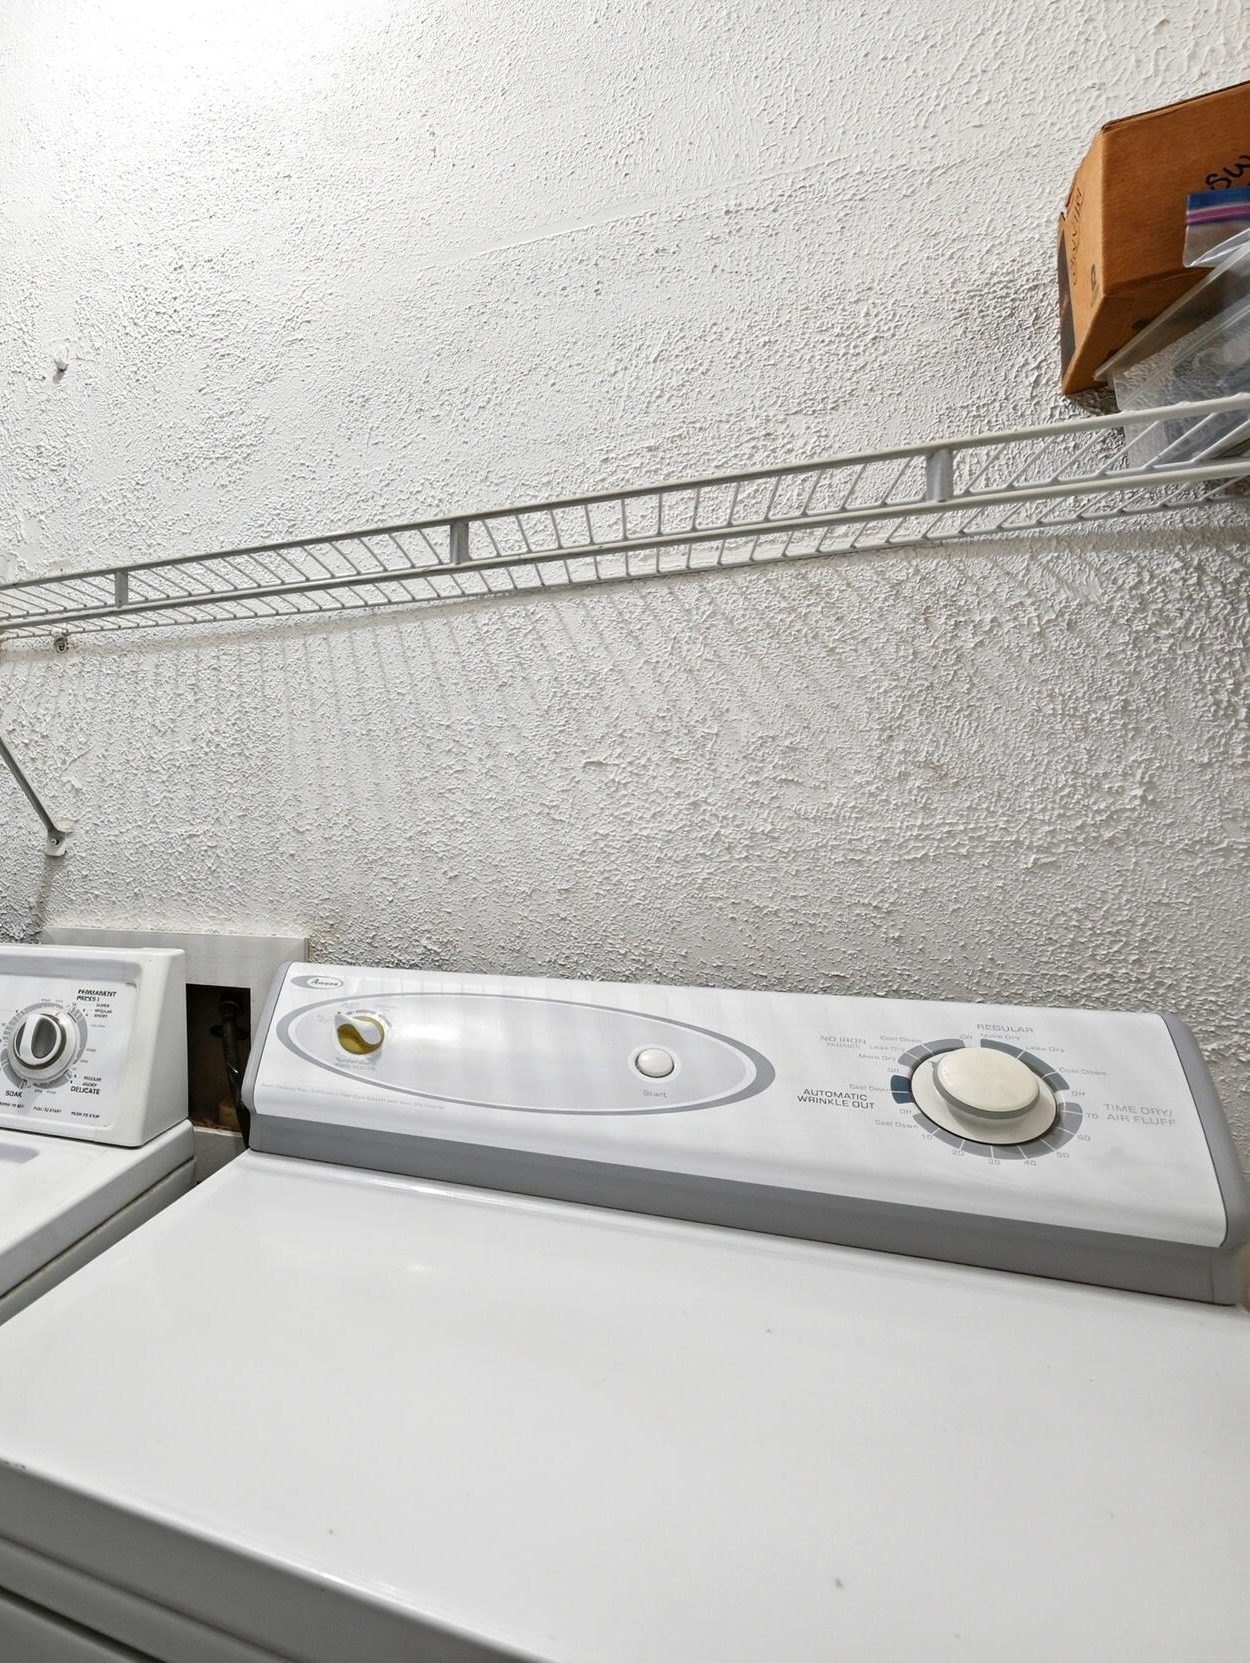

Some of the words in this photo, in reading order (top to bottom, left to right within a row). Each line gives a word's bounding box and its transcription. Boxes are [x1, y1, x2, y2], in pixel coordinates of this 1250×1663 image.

[77, 989, 117, 997] PERMANENT
[976, 1023, 1034, 1033] REGULAR
[839, 1036, 867, 1045] IRON
[881, 1055, 897, 1063] Dry
[5, 1090, 23, 1098] SOAK
[70, 1086, 101, 1095] DELICATE
[803, 1088, 868, 1102] AUTOMATIC
[797, 1095, 849, 1107] WRINKLE
[852, 1101, 876, 1110] OUT
[1104, 1103, 1137, 1114] TIME
[1141, 1106, 1174, 1117] DRY/
[874, 1119, 894, 1127] Cool
[895, 1121, 919, 1129] Down
[1107, 1113, 1130, 1123] AIR
[1133, 1116, 1177, 1127] FLUFF
[1077, 1134, 1091, 1142] 60
